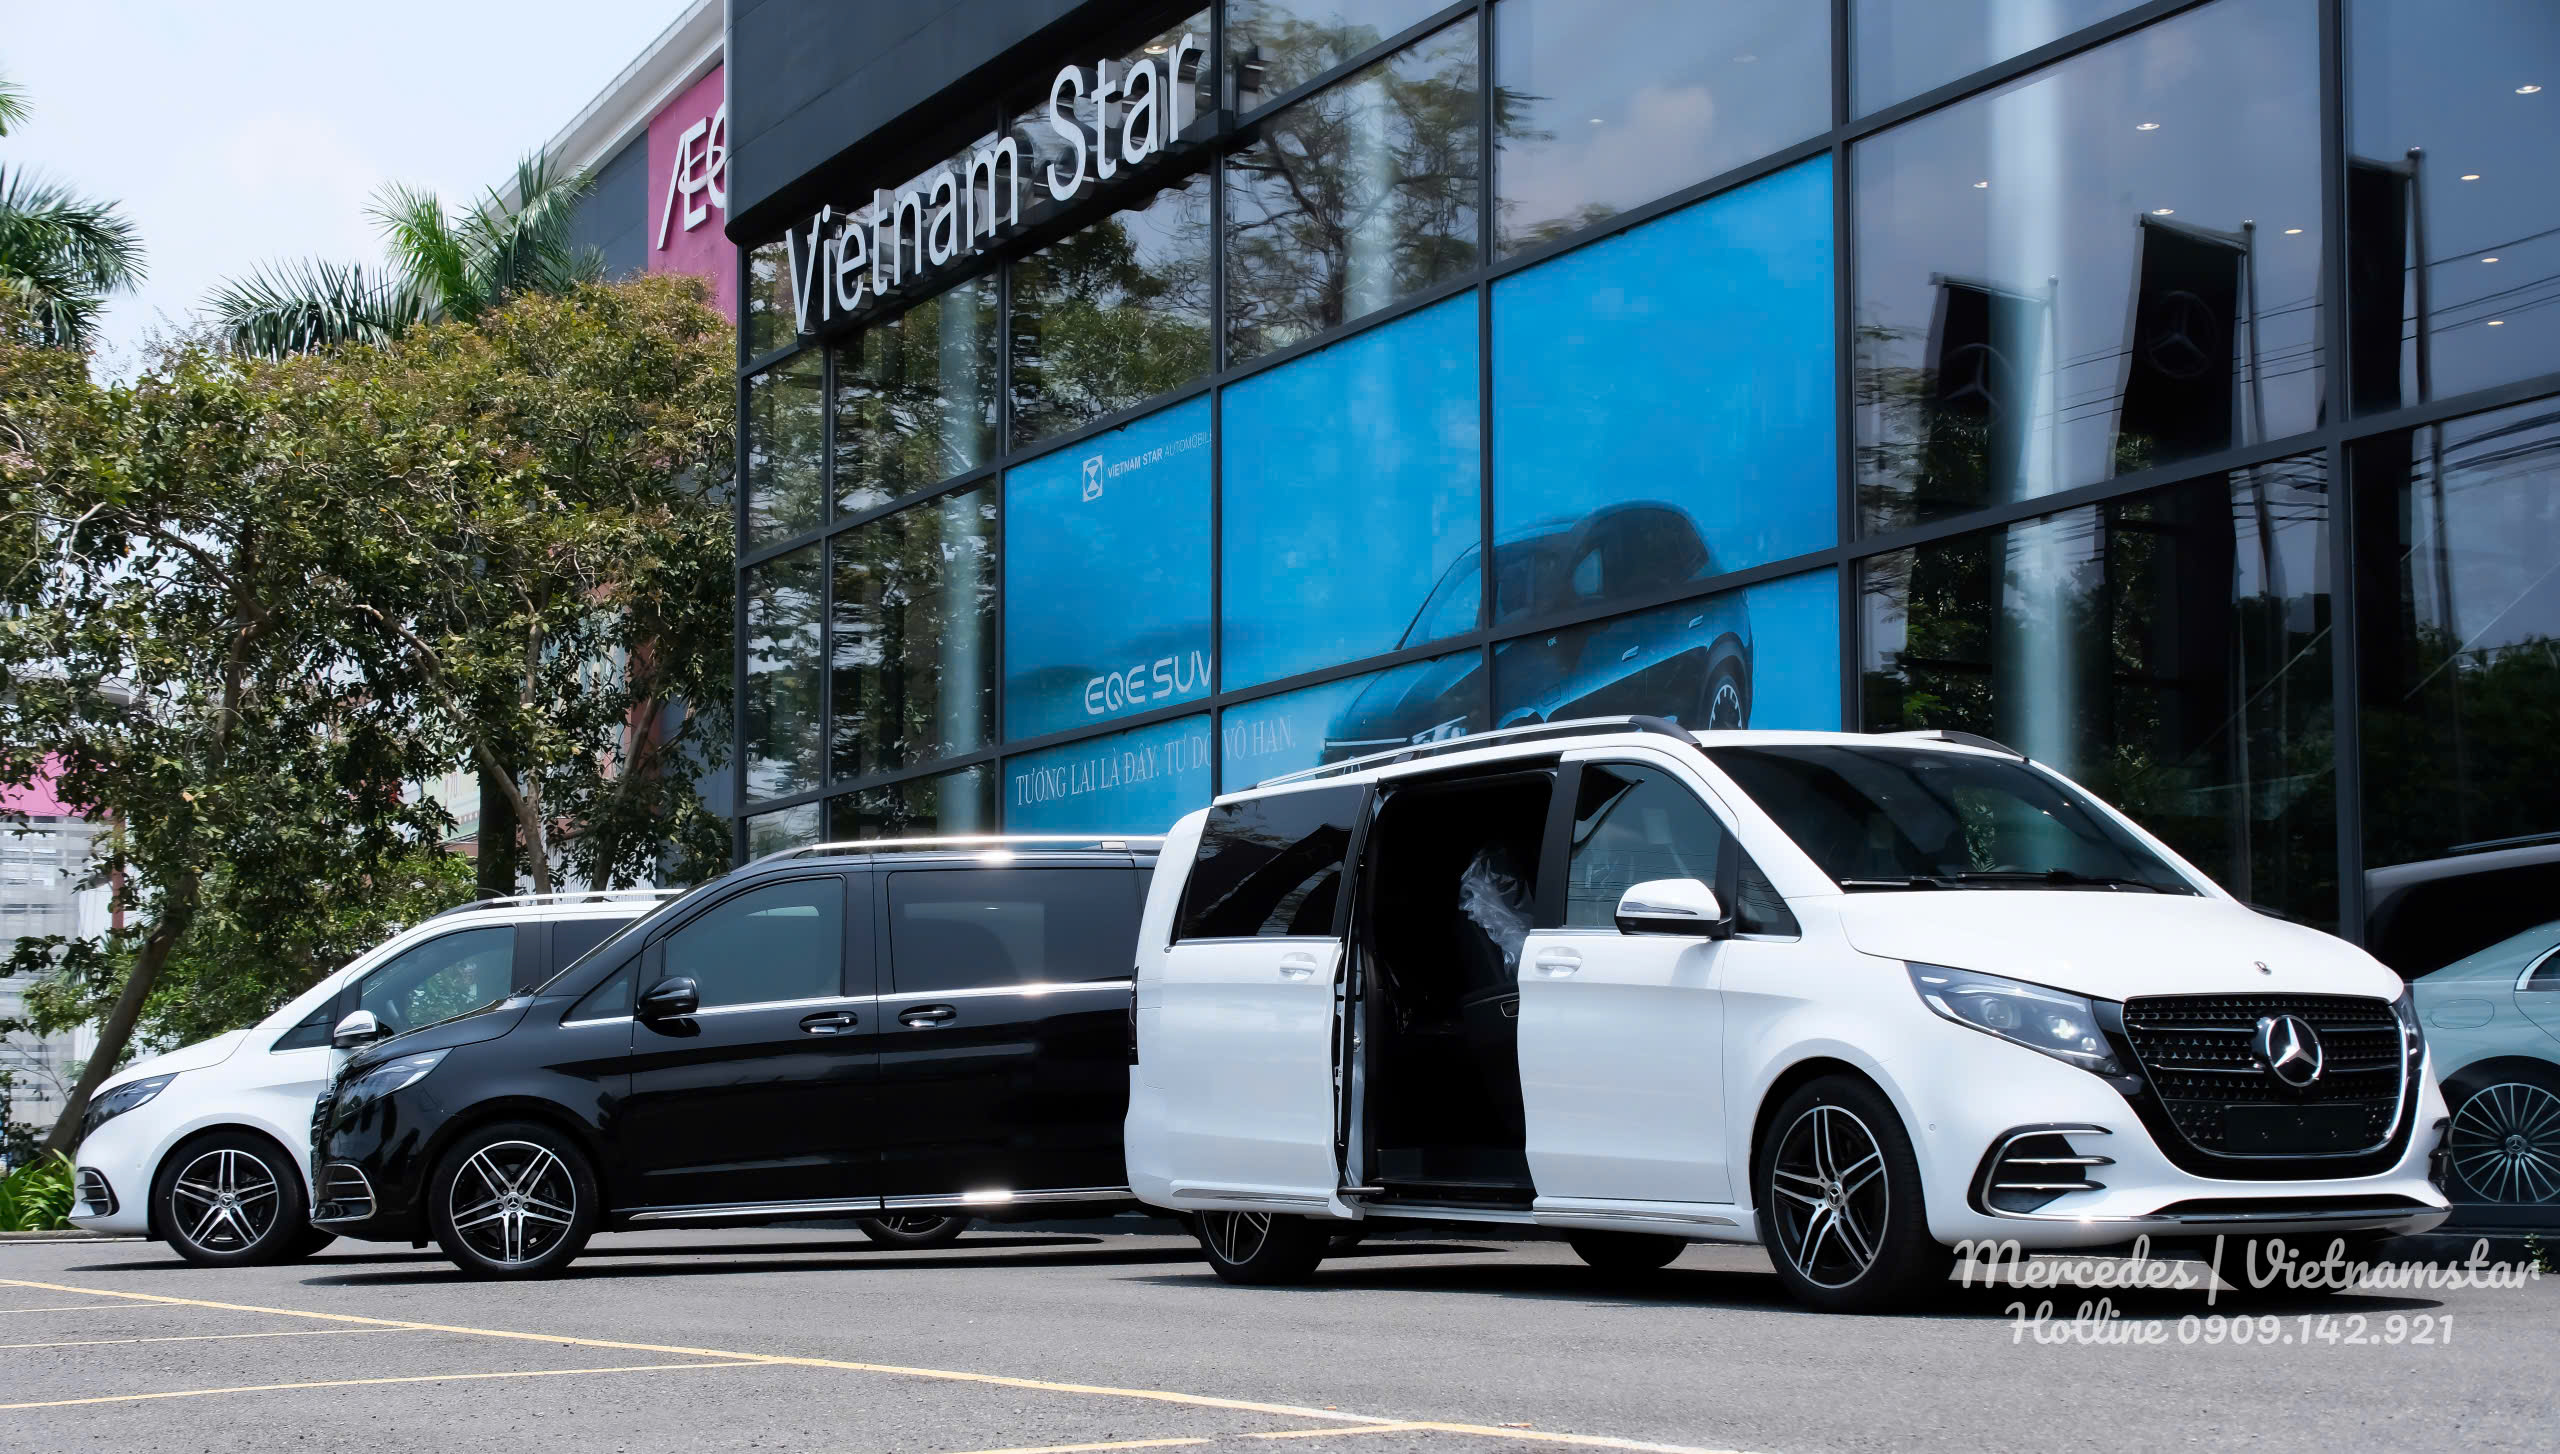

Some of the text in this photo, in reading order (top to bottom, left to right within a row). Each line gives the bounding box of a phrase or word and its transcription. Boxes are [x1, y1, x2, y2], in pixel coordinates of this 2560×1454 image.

[786, 33, 1193, 334] Vietnam Star
[1107, 431, 1212, 478] VIETNAM STAR AUTOMOBIL
[1084, 650, 1212, 715] EQE SUV
[1015, 765, 1067, 806] TƯƠNG
[1070, 759, 1097, 795] LAI
[1100, 747, 1120, 790] LÀ
[1222, 719, 1247, 761] VÔ
